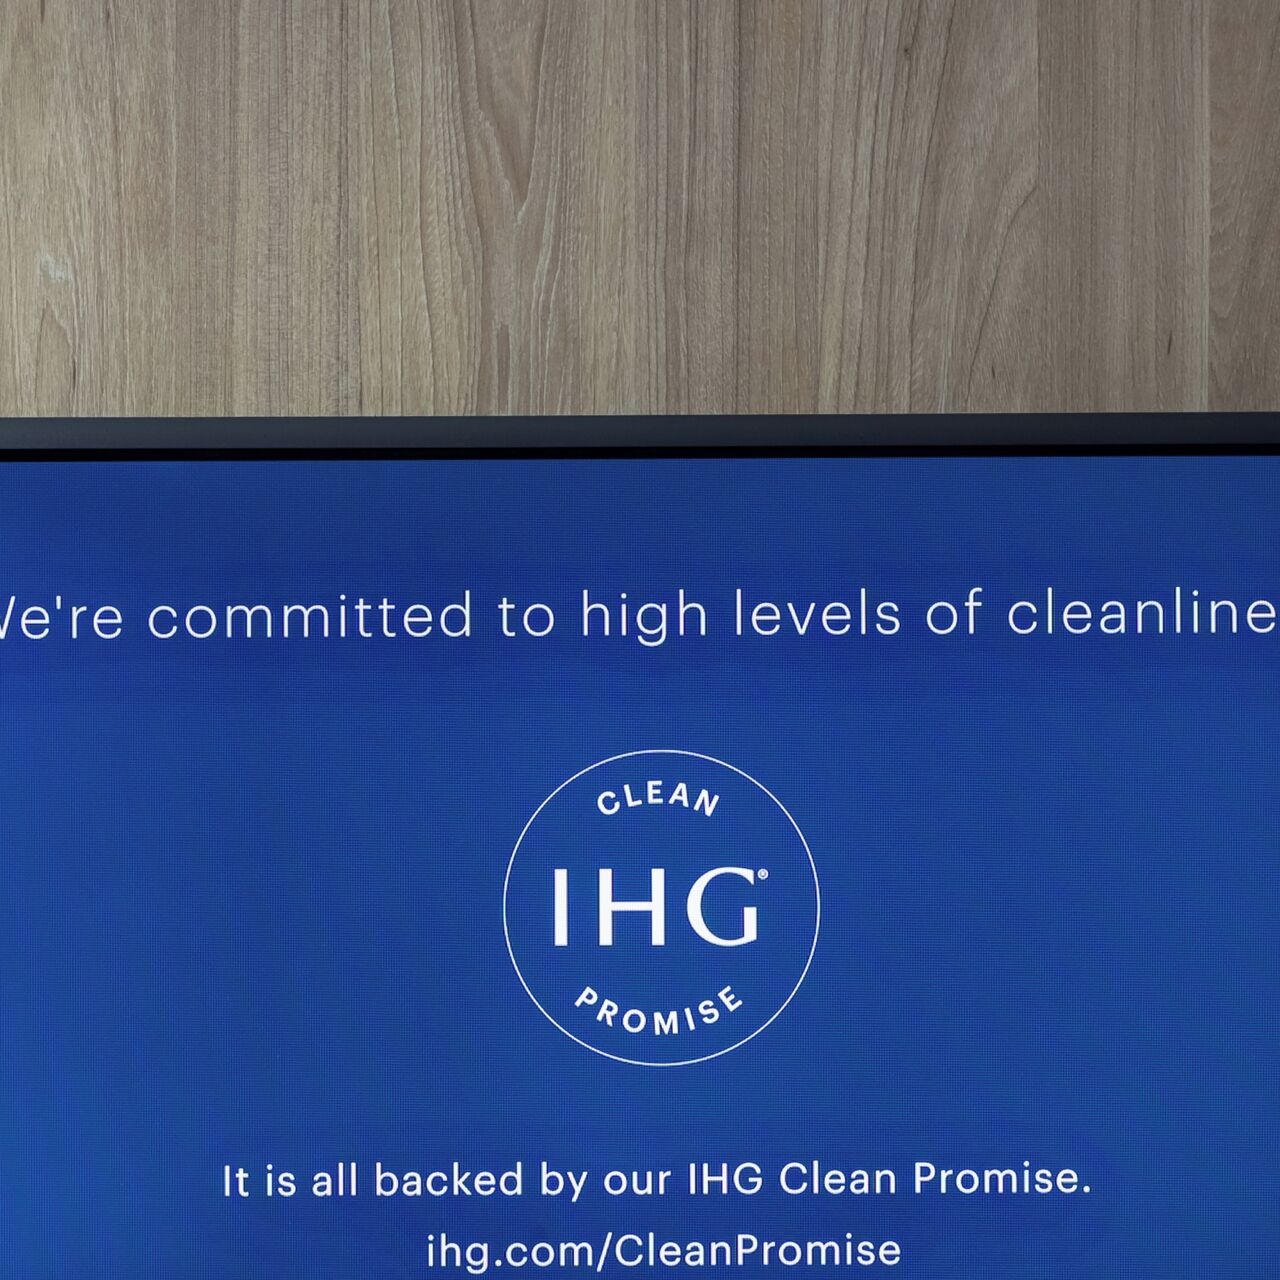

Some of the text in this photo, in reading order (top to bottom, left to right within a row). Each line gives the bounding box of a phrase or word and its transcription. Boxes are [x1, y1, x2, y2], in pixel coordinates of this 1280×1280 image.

[148, 589, 471, 639] committed
[497, 597, 555, 637] to
[582, 588, 706, 647] high
[736, 587, 901, 636] levels
[926, 587, 983, 635] of
[597, 780, 720, 817] CLEAN
[574, 985, 744, 1036] PROMISE
[224, 1160, 1091, 1203] It is all backed by our IHG Clean Promise.
[426, 1231, 901, 1275] ihg.com/CleanPromise
